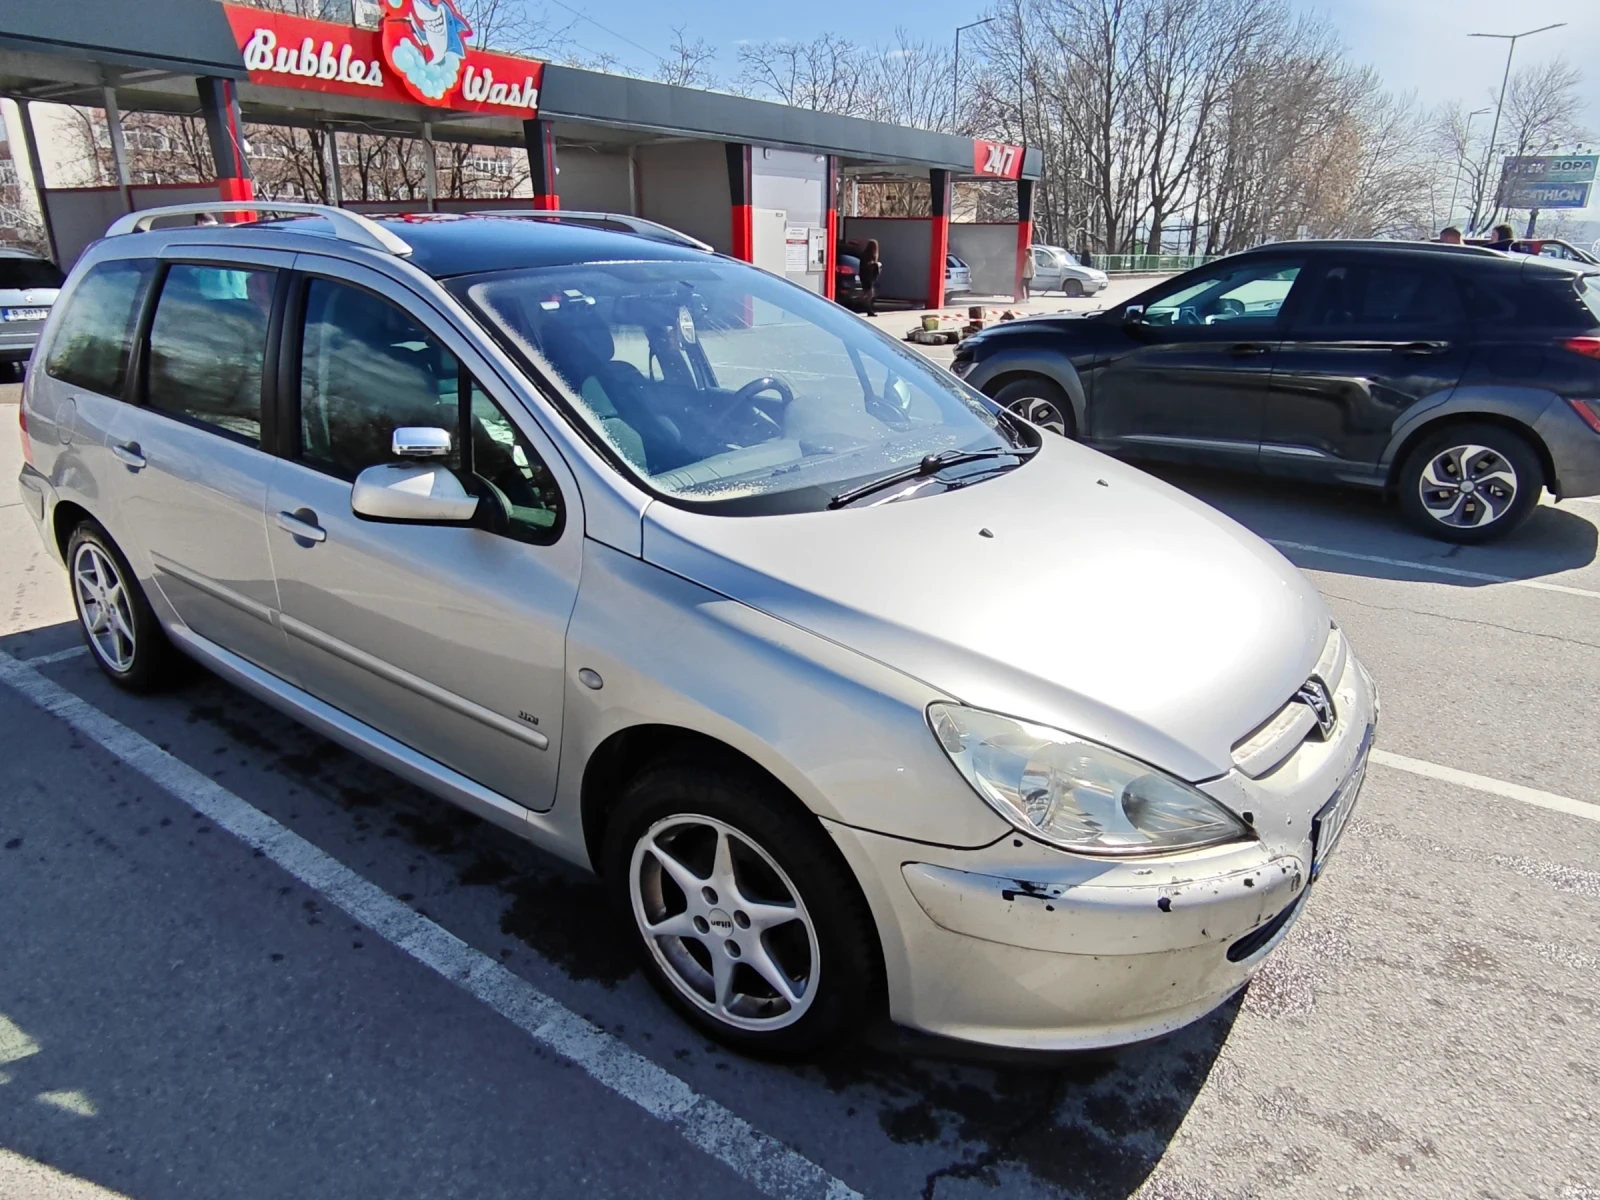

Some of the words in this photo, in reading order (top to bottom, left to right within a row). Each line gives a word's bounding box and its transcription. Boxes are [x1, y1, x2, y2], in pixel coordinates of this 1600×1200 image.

[244, 28, 383, 87] Bubbles
[462, 65, 538, 109] Wash
[983, 145, 1015, 176] 24/7
[711, 920, 731, 928] titan
